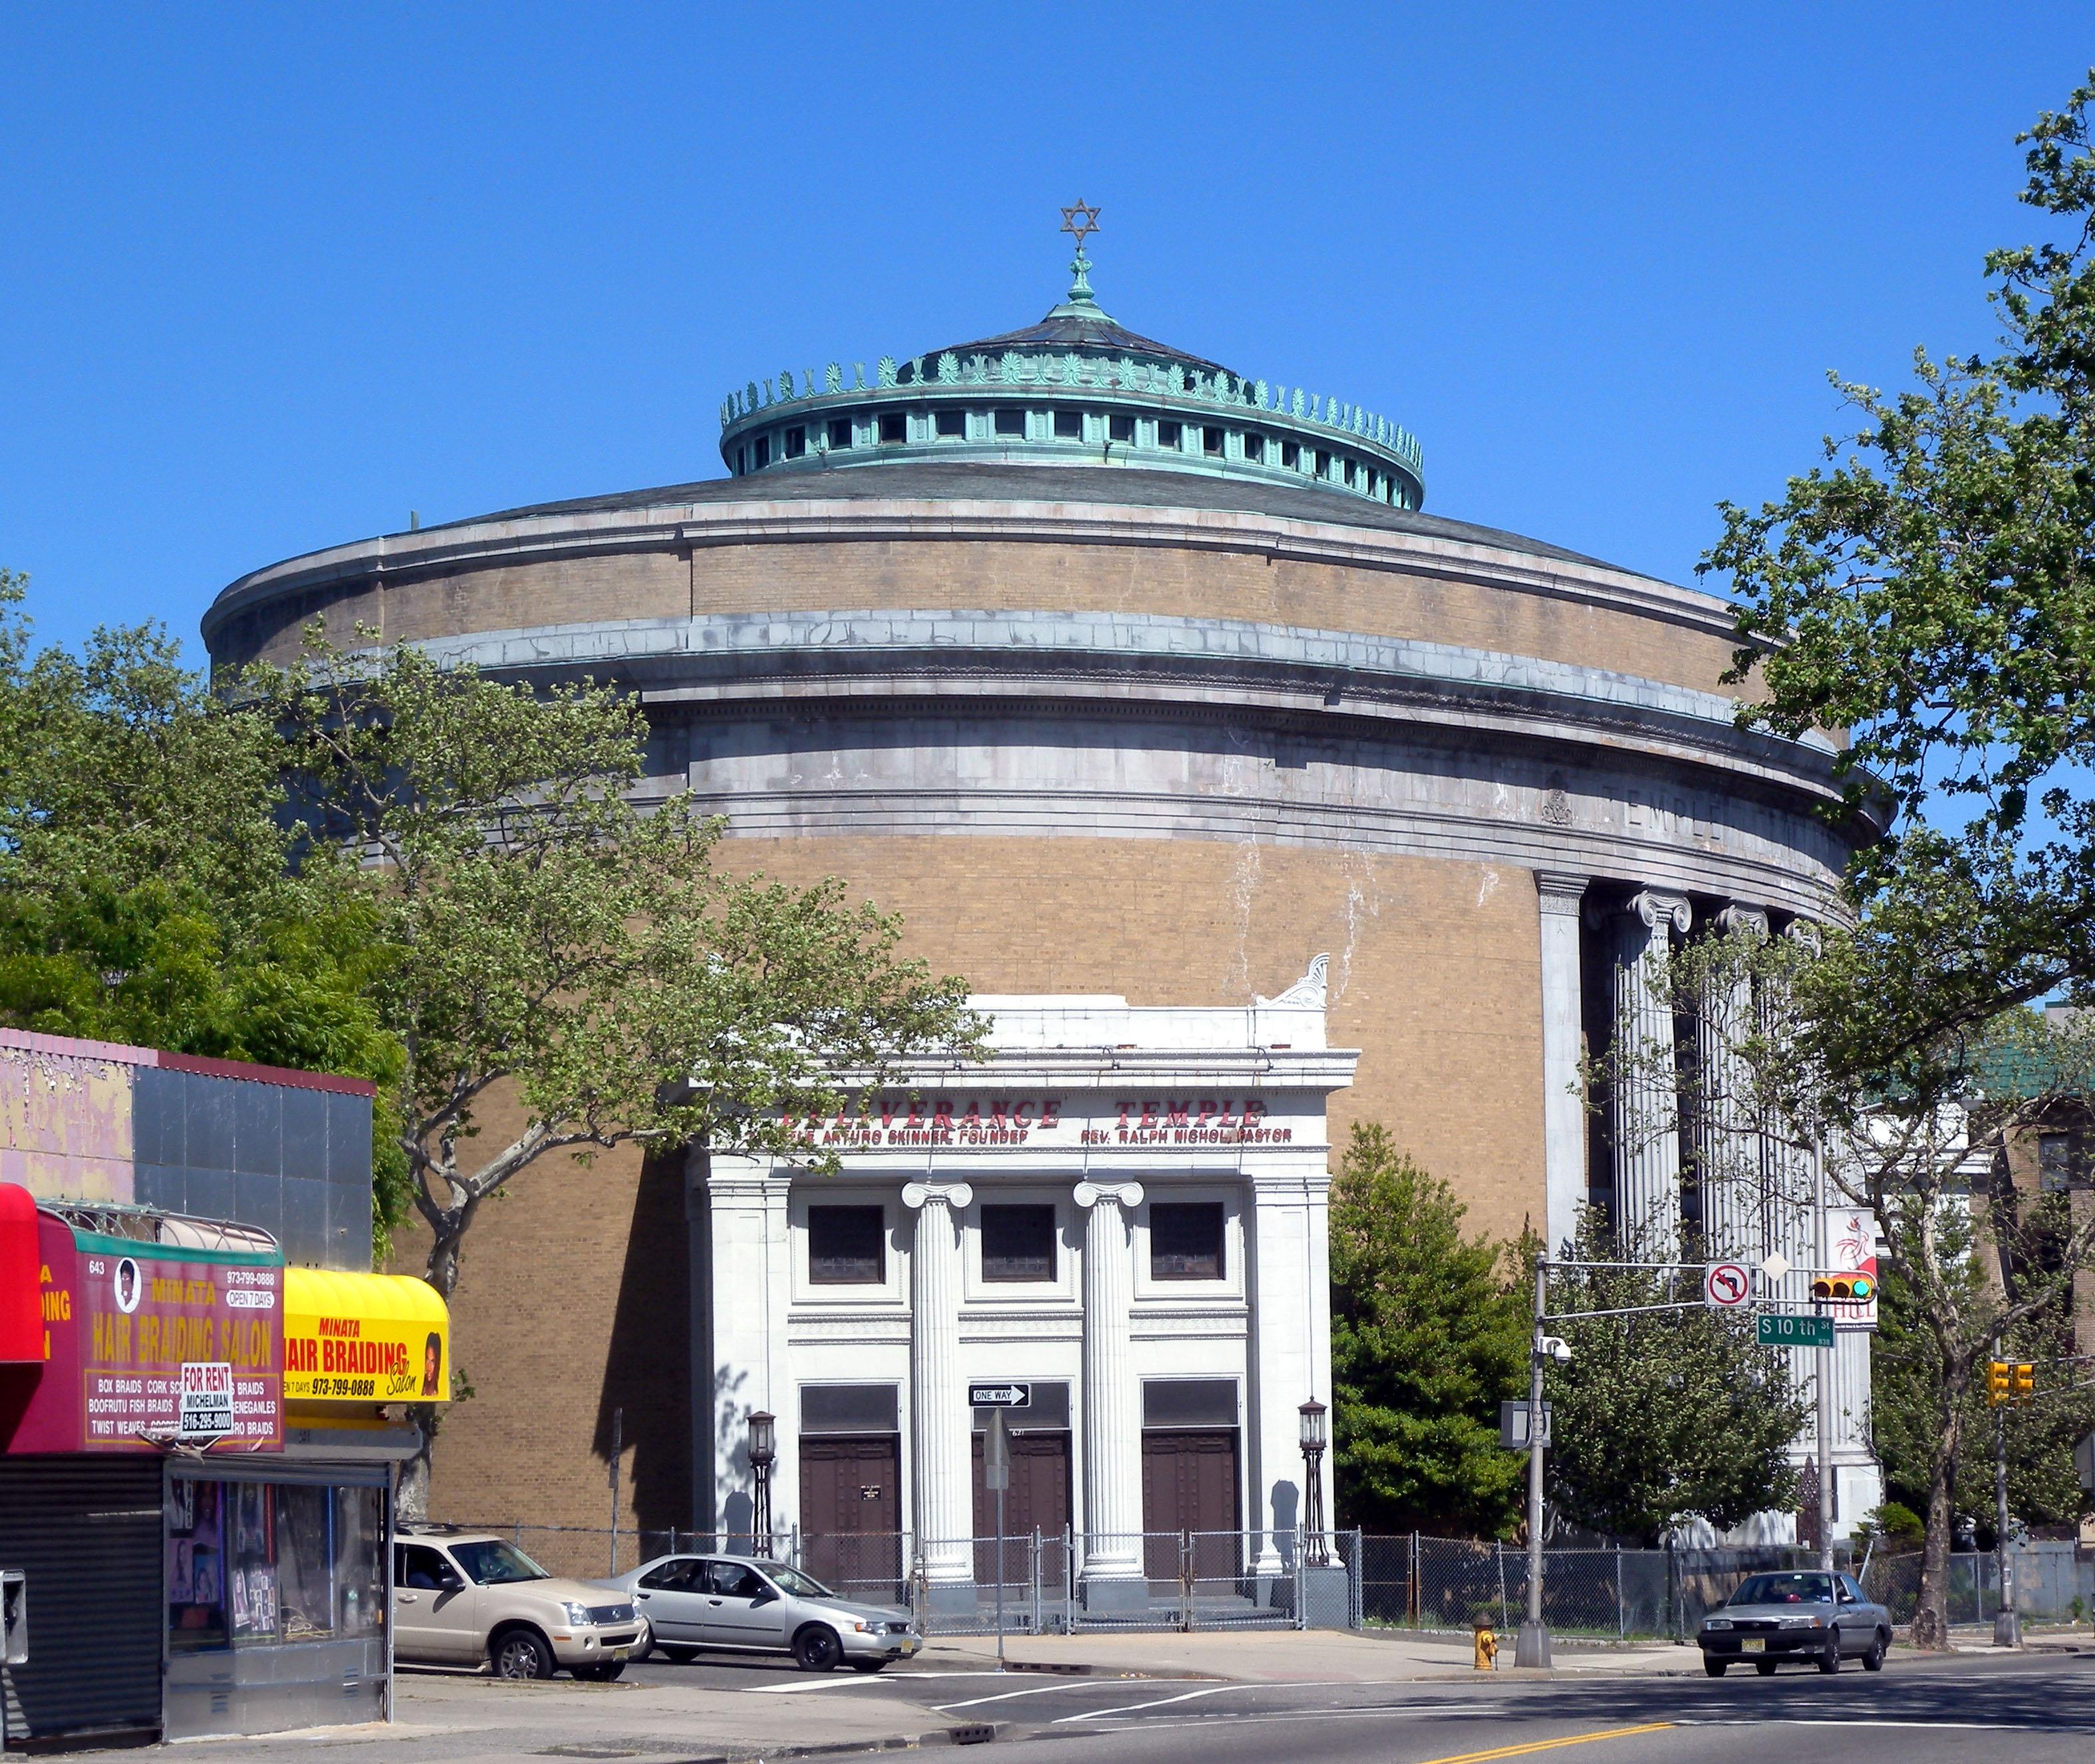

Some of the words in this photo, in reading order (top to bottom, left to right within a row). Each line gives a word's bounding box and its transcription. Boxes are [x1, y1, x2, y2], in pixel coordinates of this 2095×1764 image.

[780, 1100, 1061, 1130] LVERANCE
[1115, 1100, 1265, 1130] TEMPLE
[822, 1129, 882, 1145] ARTURO
[1119, 1129, 1168, 1144] RALPH
[1237, 1128, 1292, 1144] PASTOR
[89, 1260, 104, 1275] 643
[227, 1271, 275, 1286] 973-799-0888
[151, 1277, 216, 1305] MINATA
[229, 1292, 249, 1305] OPEN
[249, 1293, 254, 1305] 7
[254, 1293, 272, 1306] DAYS
[319, 1318, 360, 1338] MINATA
[1762, 1319, 1772, 1334] S
[1777, 1319, 1794, 1334] 10
[1799, 1320, 1816, 1336] th
[92, 1312, 131, 1362] HAIR
[138, 1315, 213, 1362] BRAIDING
[220, 1319, 271, 1367] SALON
[323, 1339, 407, 1376] BRAIDING
[98, 1379, 113, 1393] BOX
[116, 1380, 142, 1394] BRAIDS
[147, 1380, 167, 1394] CORK
[184, 1366, 204, 1392] FOR
[206, 1366, 229, 1392] RENT
[387, 1360, 417, 1396] Salon
[237, 1382, 264, 1395] BRAIDS
[296, 1382, 310, 1393] DAYS
[312, 1378, 374, 1396] 973-799-0888
[976, 1391, 992, 1400] ONE
[995, 1391, 1012, 1400] WAY
[130, 1399, 145, 1413] FISH
[148, 1399, 173, 1413] BRAIDS
[186, 1394, 228, 1408] MICHELMAN
[92, 1420, 114, 1435] TWIST
[117, 1420, 145, 1435] WEAVES
[184, 1412, 231, 1430] 516-295-9000
[247, 1422, 273, 1436] BRAIDS
